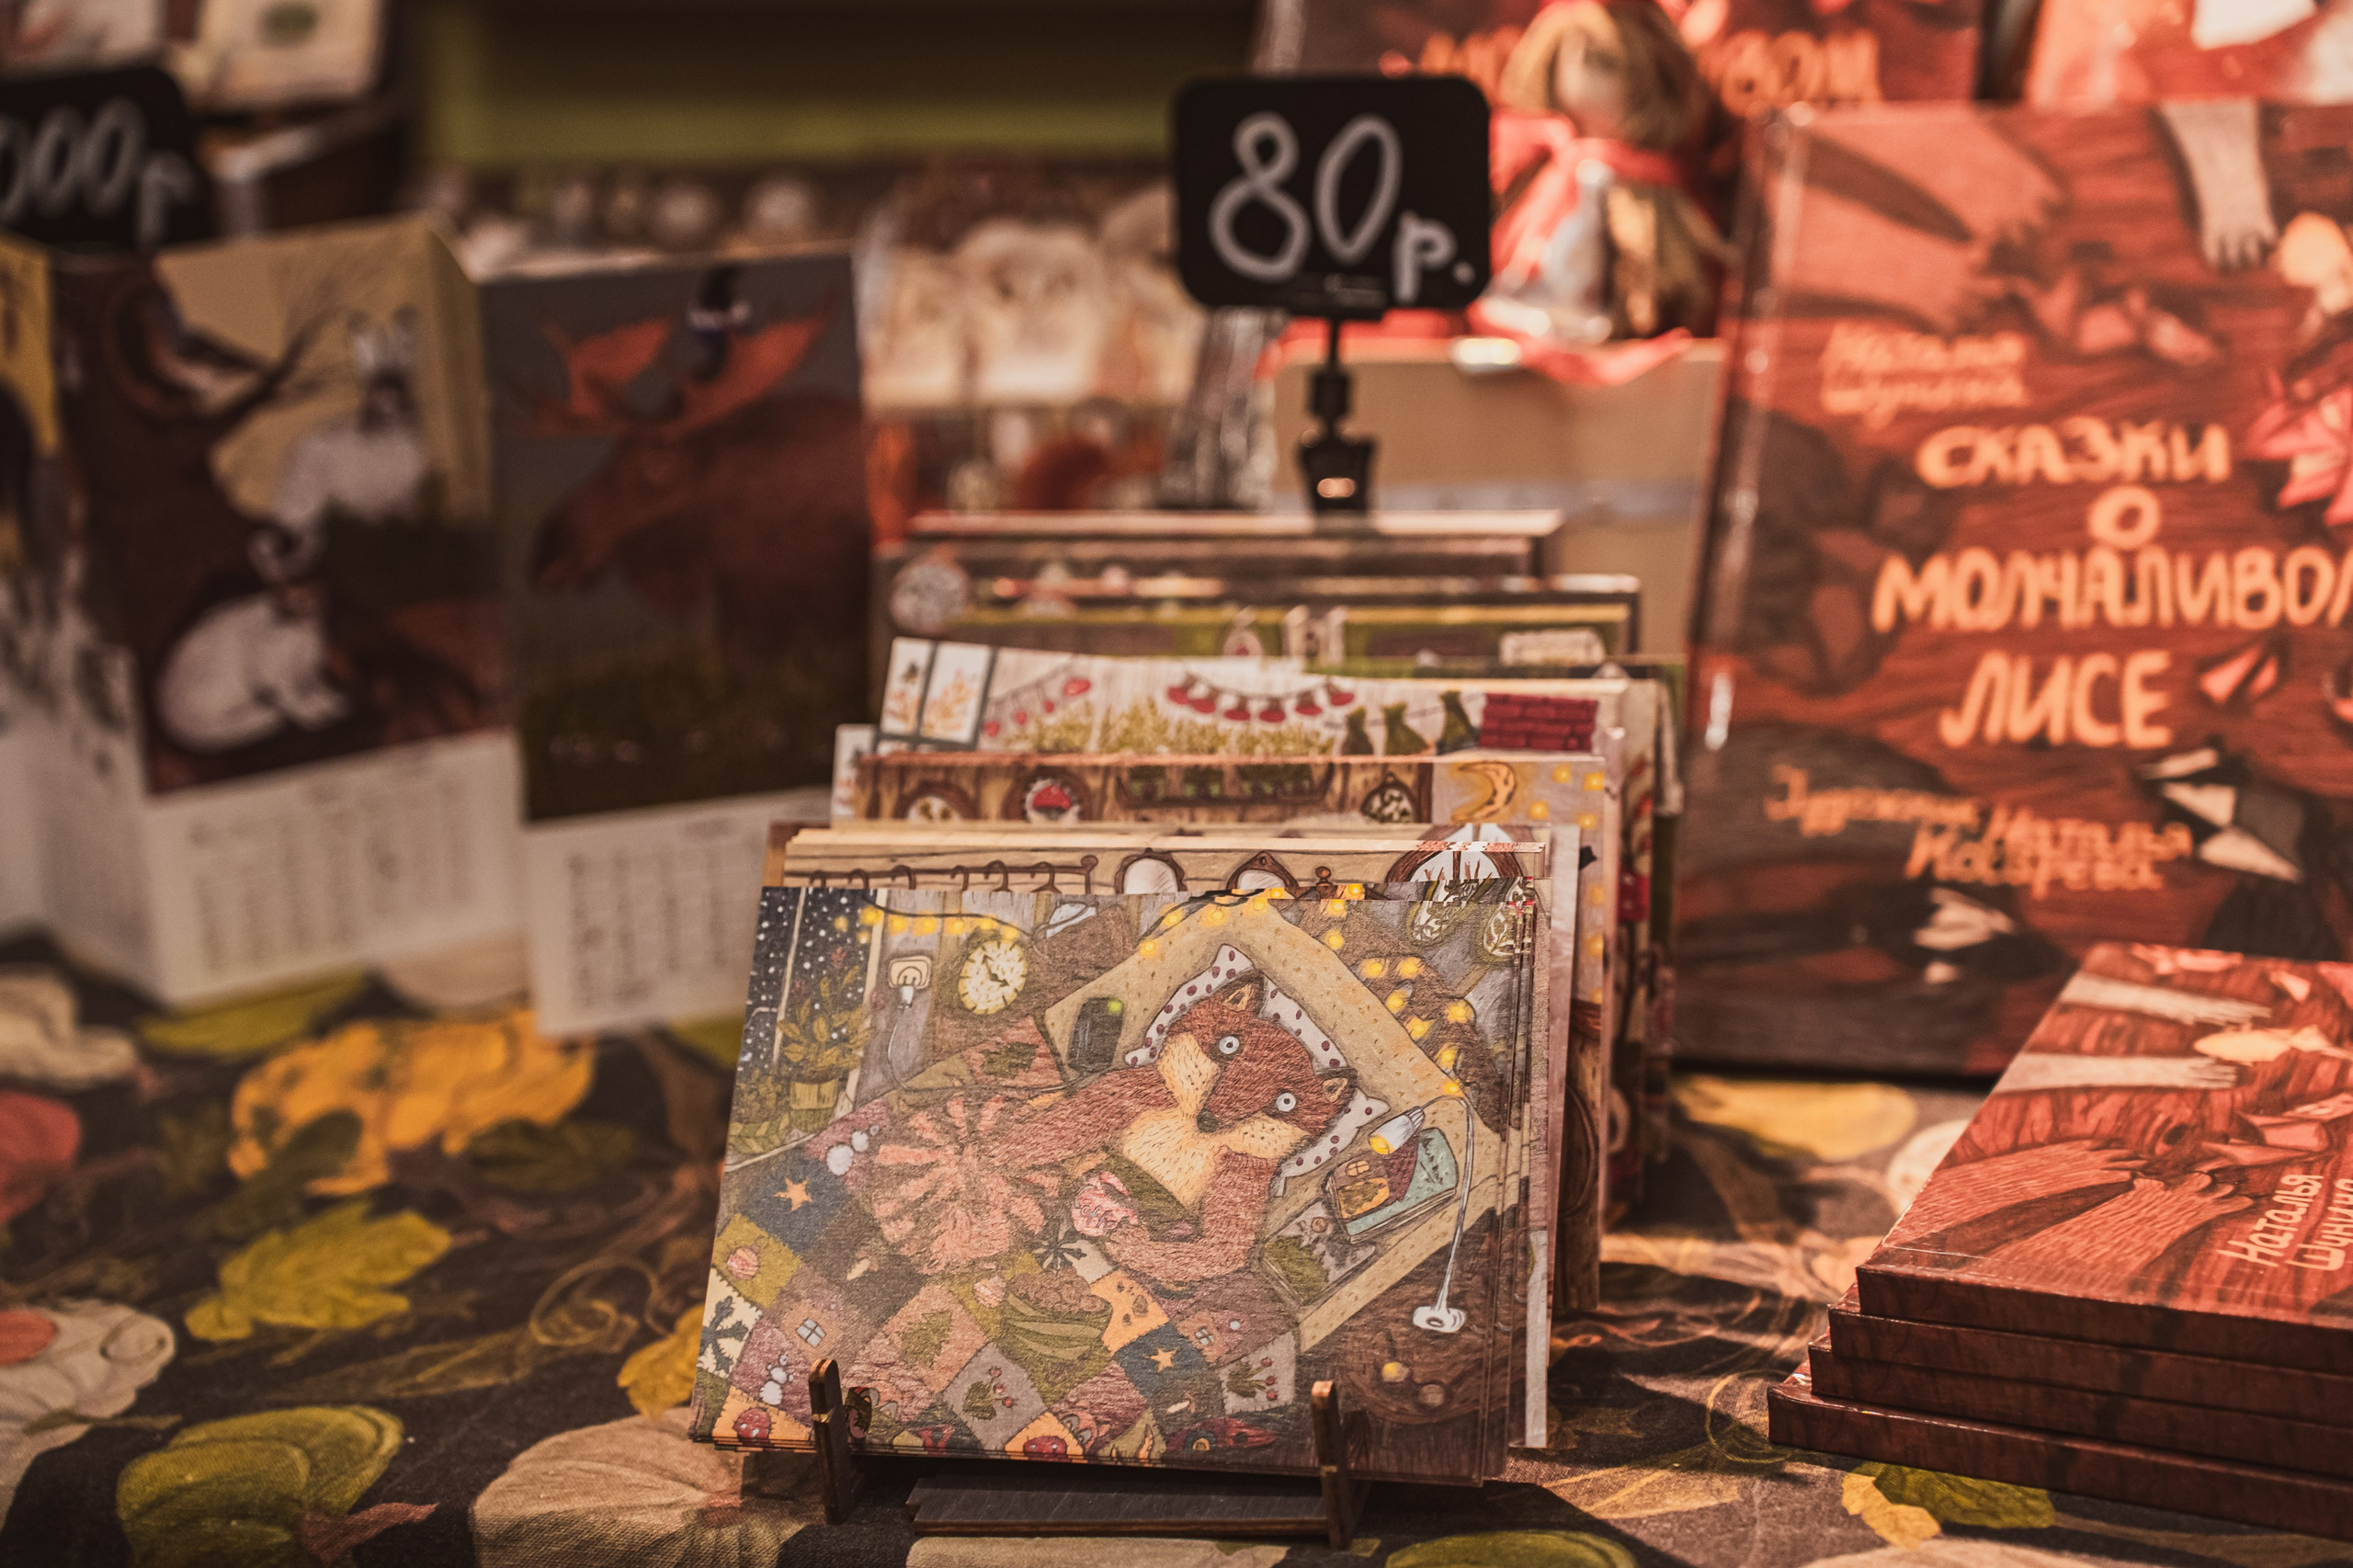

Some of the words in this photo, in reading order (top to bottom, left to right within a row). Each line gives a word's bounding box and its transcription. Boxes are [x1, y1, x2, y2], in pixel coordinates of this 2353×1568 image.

[1917, 417, 2231, 488] СКАЗКИ
[2087, 484, 2163, 550] О
[1938, 648, 2174, 752] ЛИСЕ
[2215, 1174, 2325, 1267] Наталья
